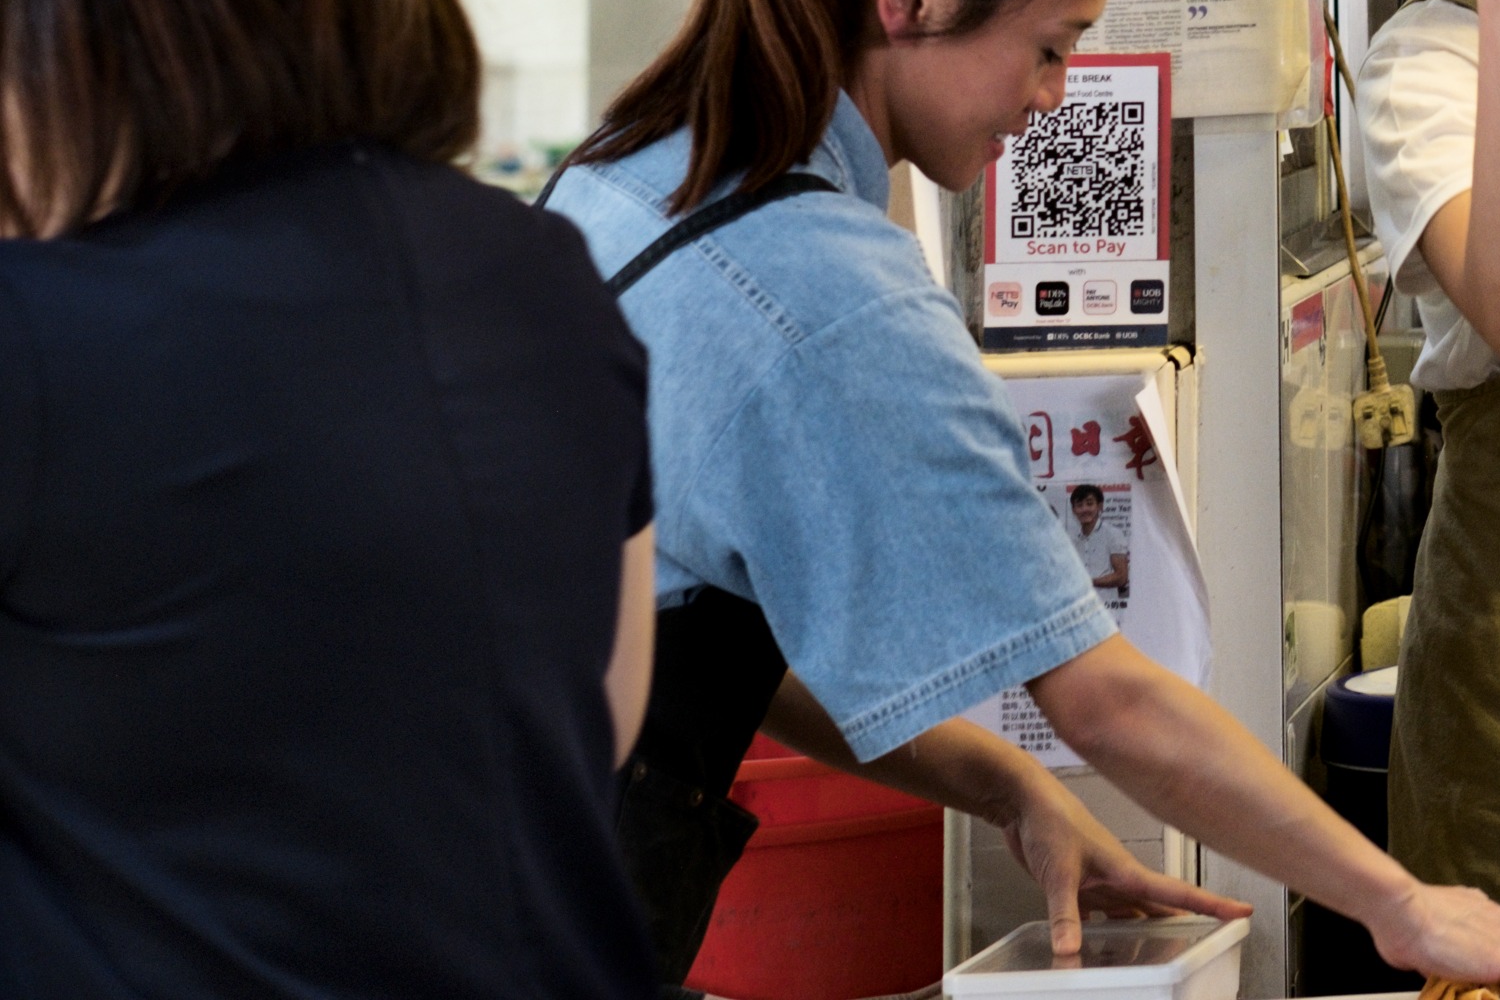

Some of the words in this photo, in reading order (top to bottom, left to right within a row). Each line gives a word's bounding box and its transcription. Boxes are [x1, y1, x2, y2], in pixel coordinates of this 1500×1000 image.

[1082, 74, 1112, 83] BREAK
[1066, 165, 1094, 176] NETS
[1027, 240, 1068, 255] Scan
[1073, 240, 1091, 254] to
[1097, 239, 1126, 256] Pay
[1068, 267, 1086, 276] with
[1142, 289, 1162, 297] UOB
[1001, 299, 1019, 309] Pay
